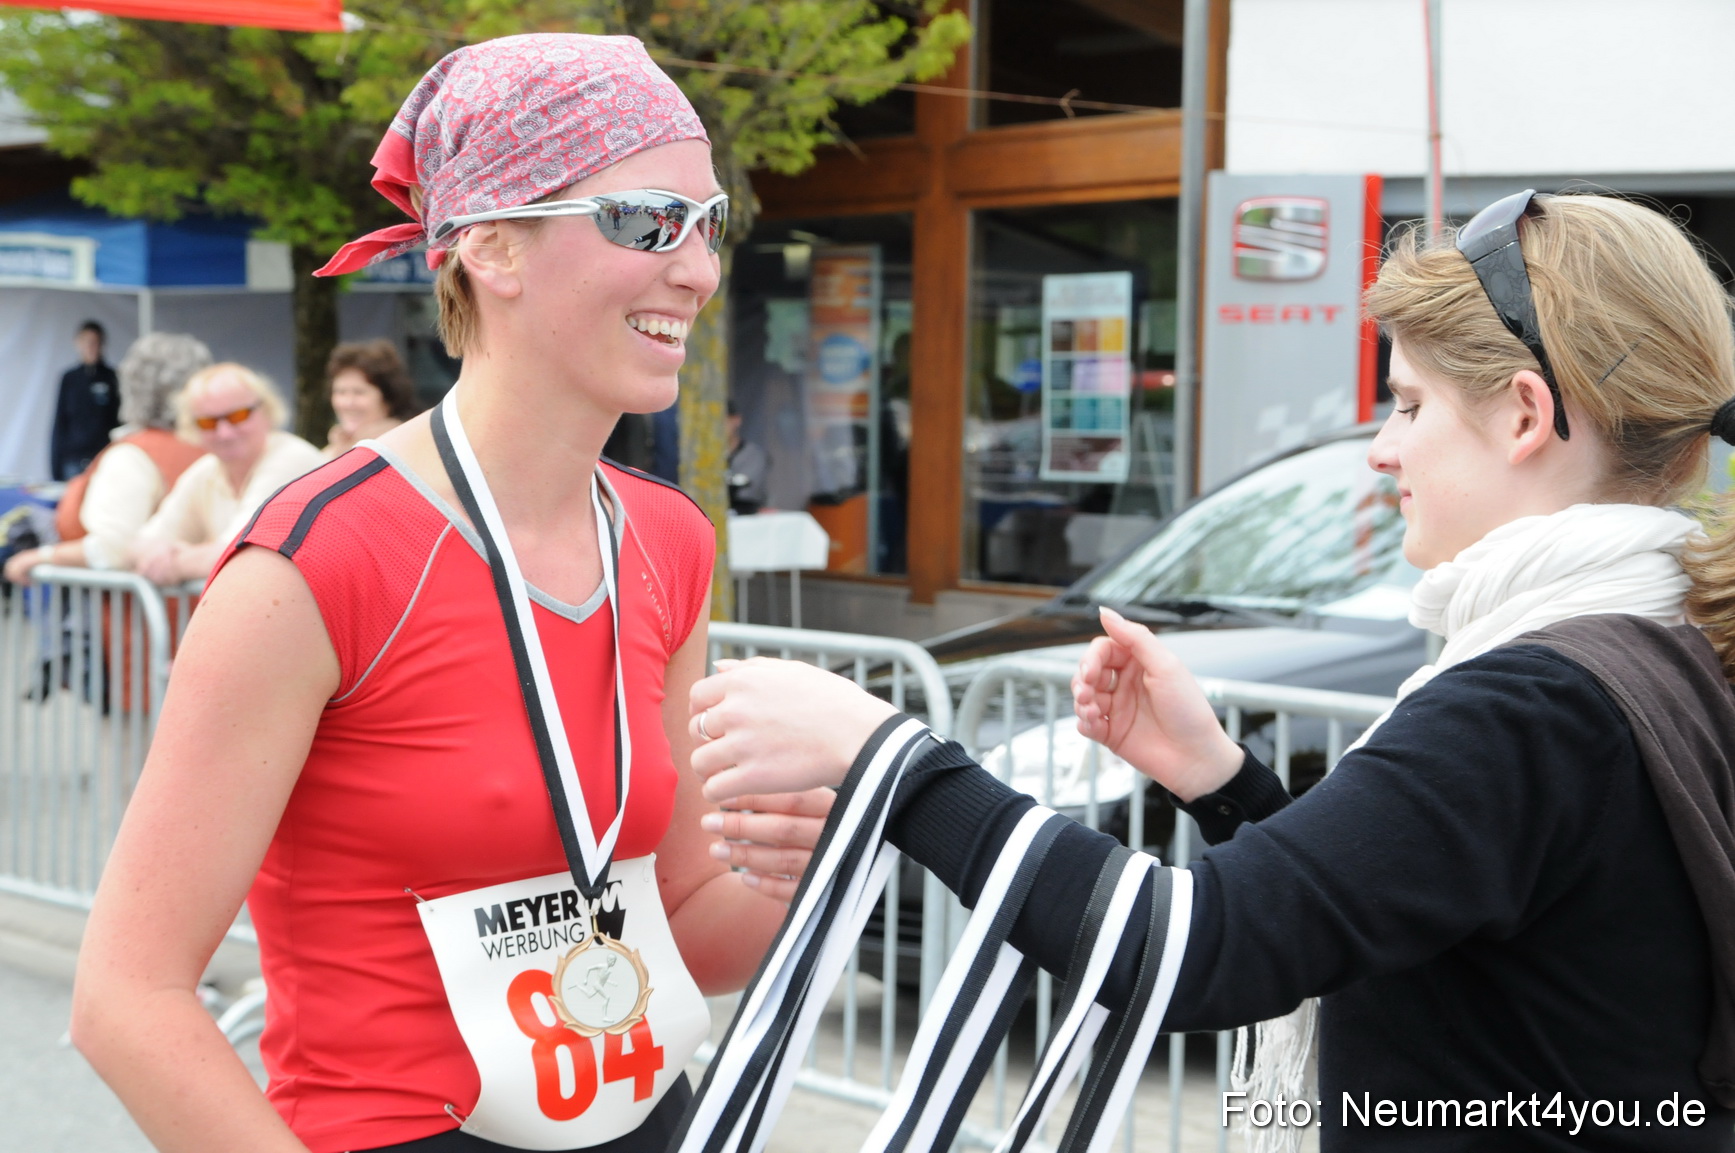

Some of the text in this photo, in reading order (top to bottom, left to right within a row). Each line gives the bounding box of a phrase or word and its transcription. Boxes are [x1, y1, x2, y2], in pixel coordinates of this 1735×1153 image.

[1217, 303, 1343, 324] SEAT
[474, 889, 581, 938] MEYER
[481, 922, 585, 960] WERBUNG
[507, 969, 664, 1121] 84
